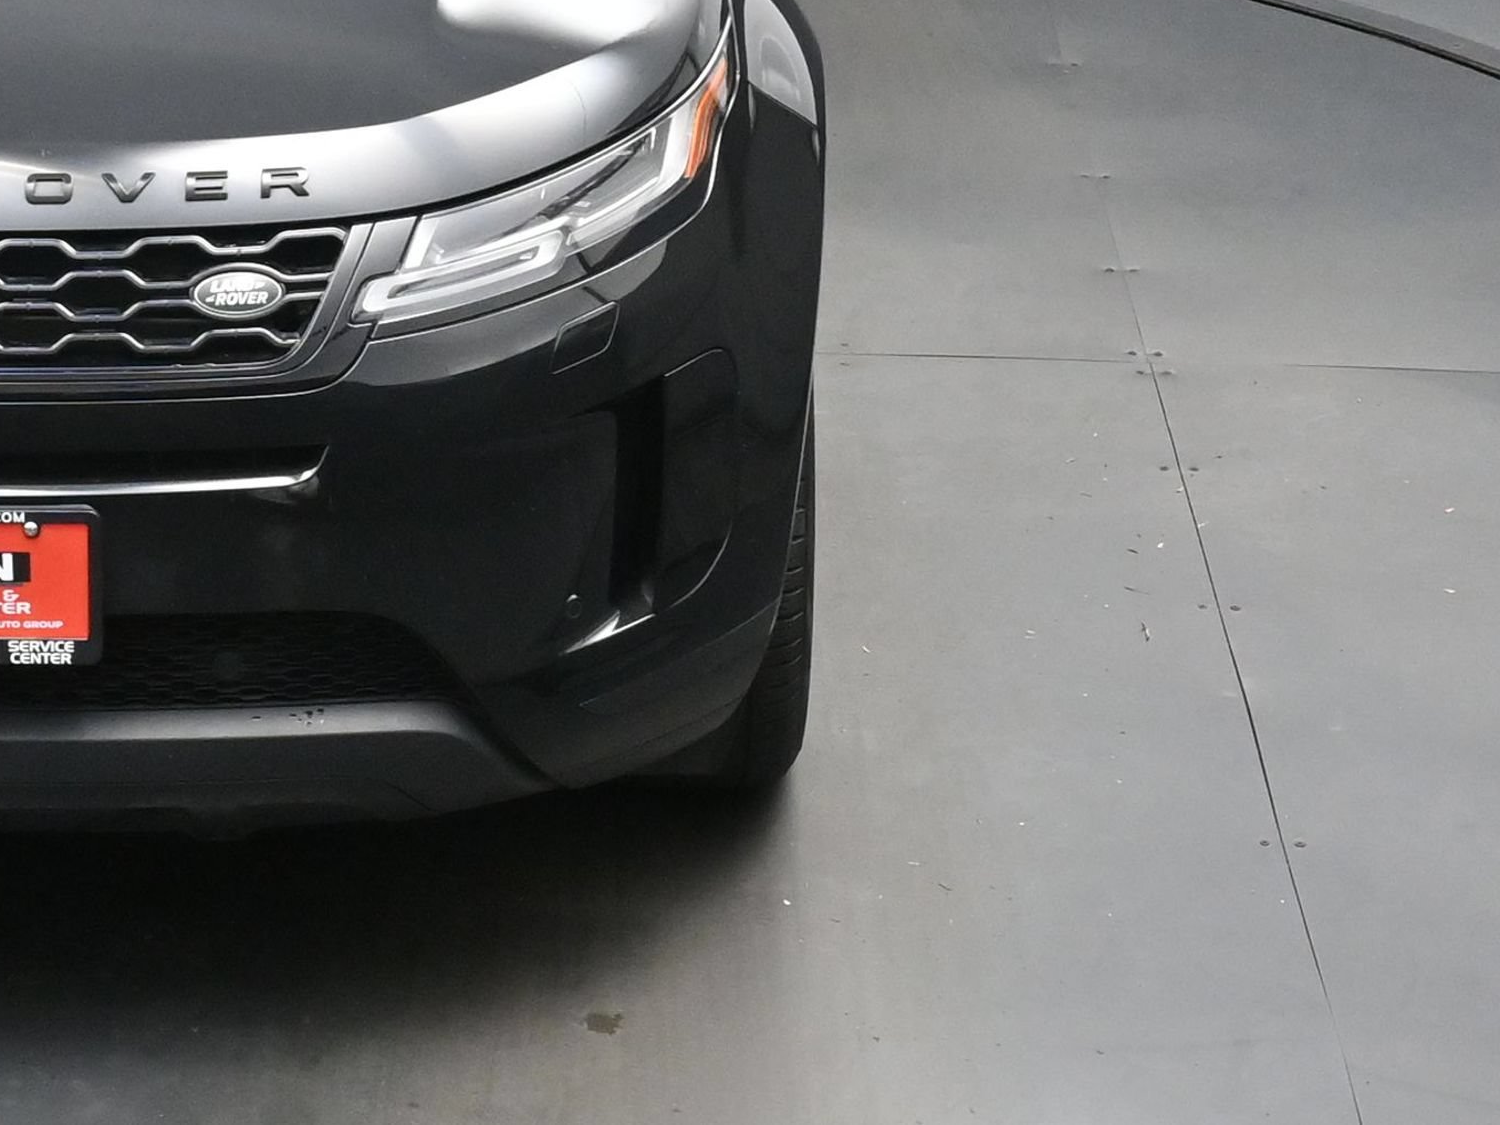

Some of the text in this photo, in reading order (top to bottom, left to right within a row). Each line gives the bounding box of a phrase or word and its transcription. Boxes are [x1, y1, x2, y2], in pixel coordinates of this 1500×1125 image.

[209, 279, 253, 293] LAND
[214, 291, 269, 306] ROVER
[2, 589, 19, 602] &
[23, 620, 64, 629] GROUP
[7, 640, 75, 653] SERVICE
[10, 652, 72, 665] CENTER
